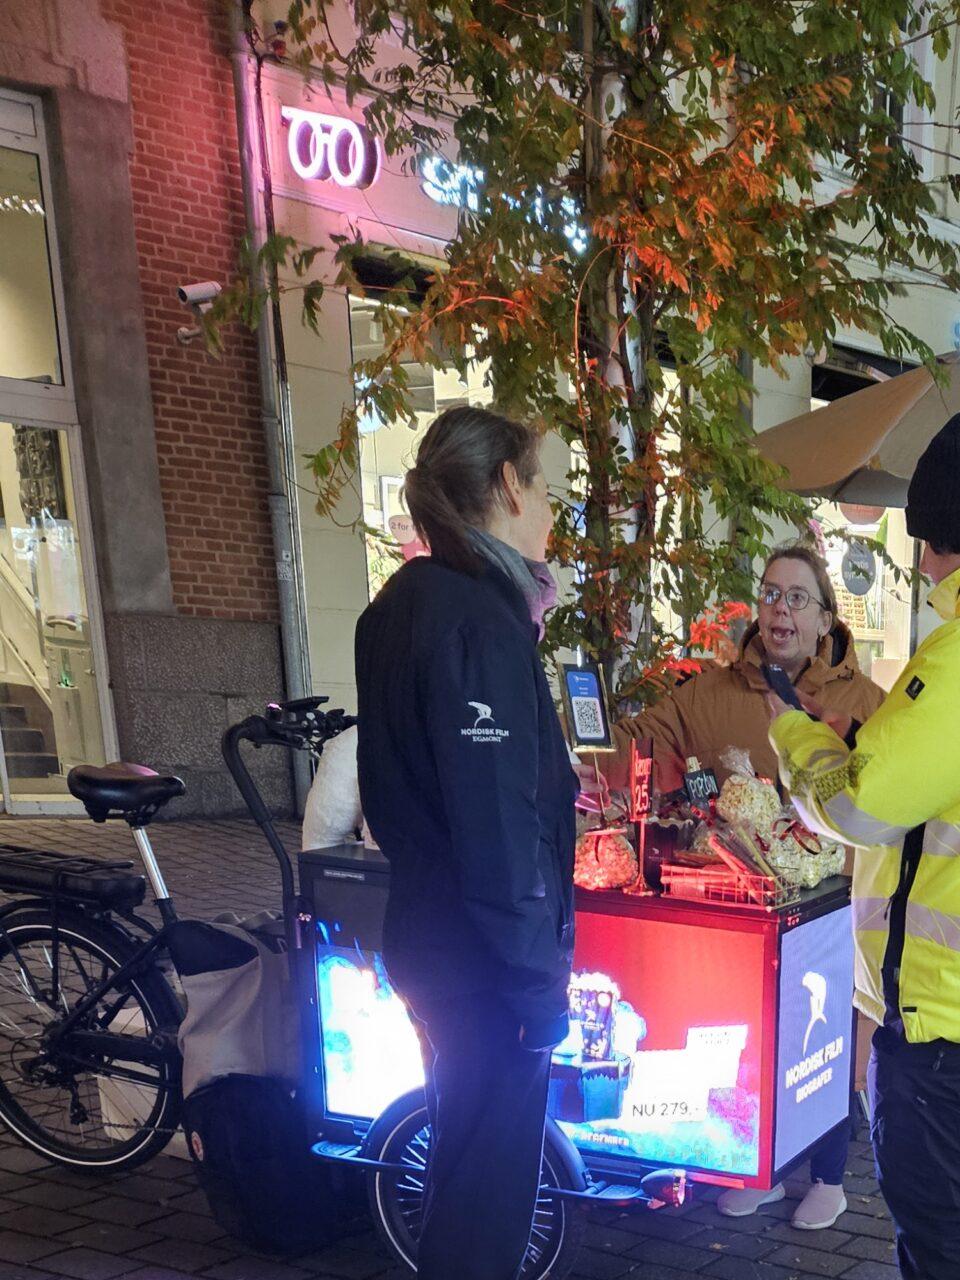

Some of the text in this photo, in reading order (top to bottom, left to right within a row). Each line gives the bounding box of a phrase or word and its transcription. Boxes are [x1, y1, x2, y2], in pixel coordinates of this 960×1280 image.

[398, 522, 409, 531] for
[460, 728, 510, 737] NORDISK FILM
[785, 1035, 844, 1090] NORDISK FILM
[795, 1067, 833, 1104] BIOGRAFER
[632, 1103, 655, 1117] NU
